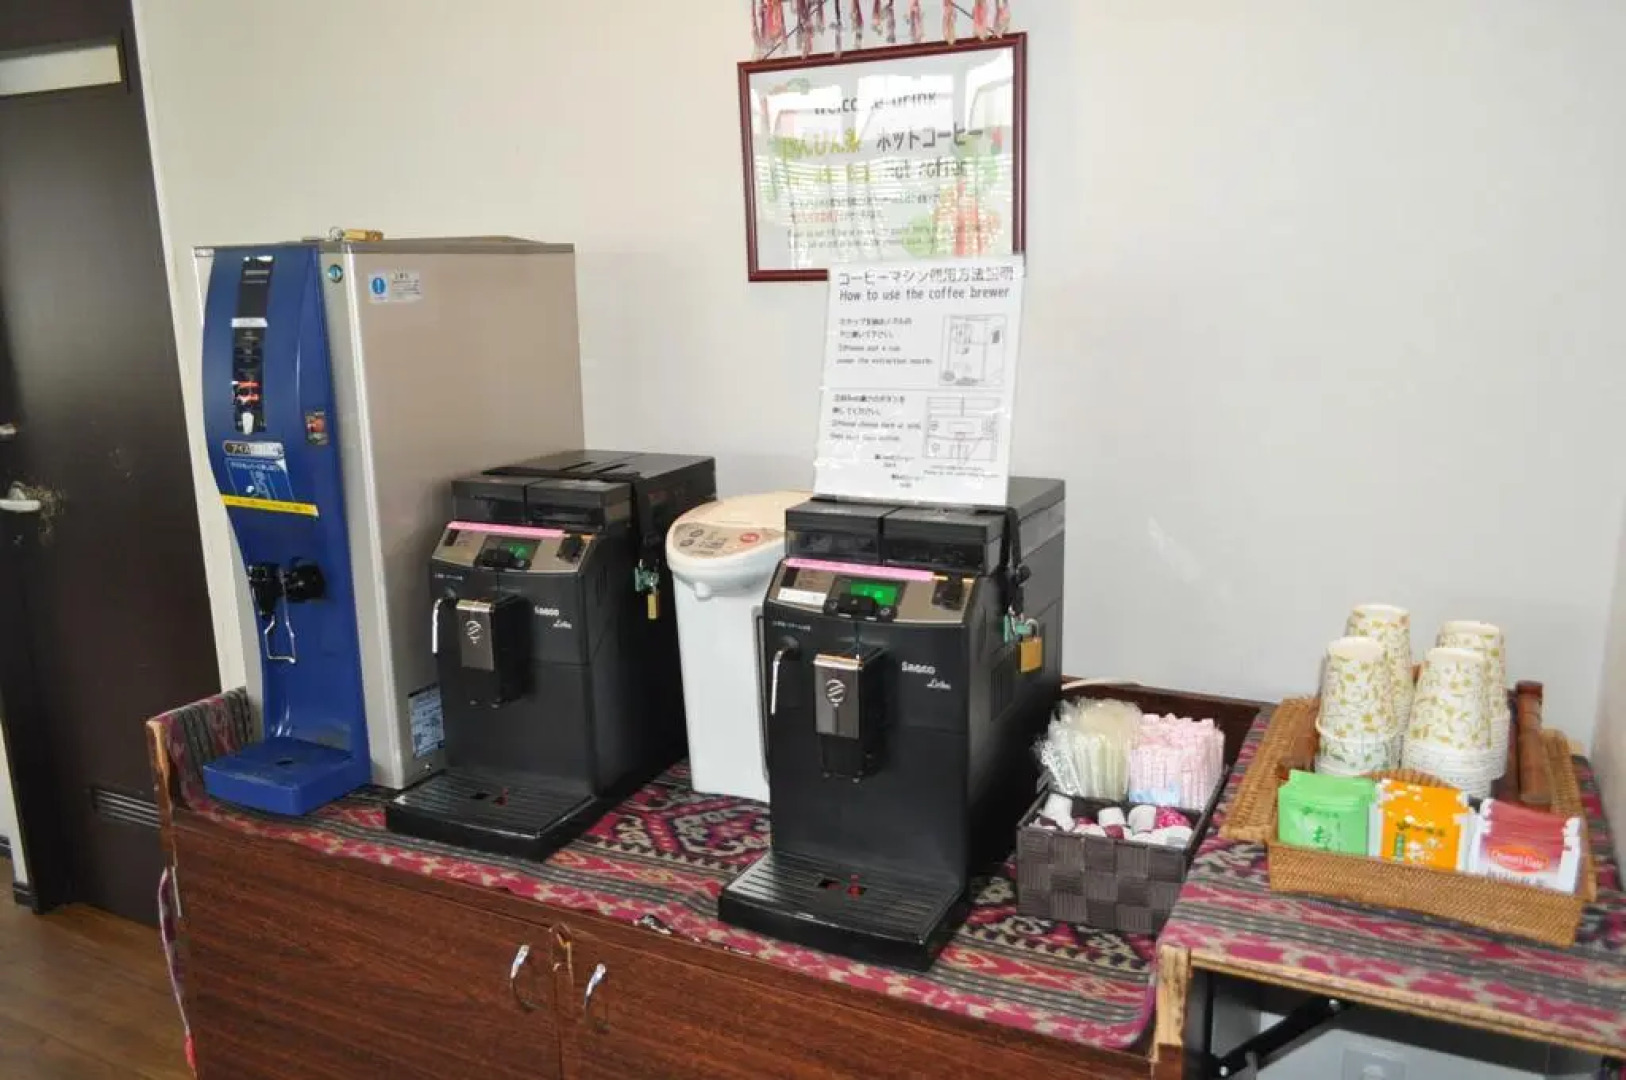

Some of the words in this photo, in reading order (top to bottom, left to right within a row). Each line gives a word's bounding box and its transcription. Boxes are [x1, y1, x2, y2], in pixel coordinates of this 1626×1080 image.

[876, 121, 984, 152] ホットコーヒー
[839, 289, 861, 301] How
[867, 289, 879, 301] to
[882, 290, 901, 301] use
[906, 288, 924, 300] the
[928, 286, 966, 300] coffee
[969, 285, 1010, 299] brewer
